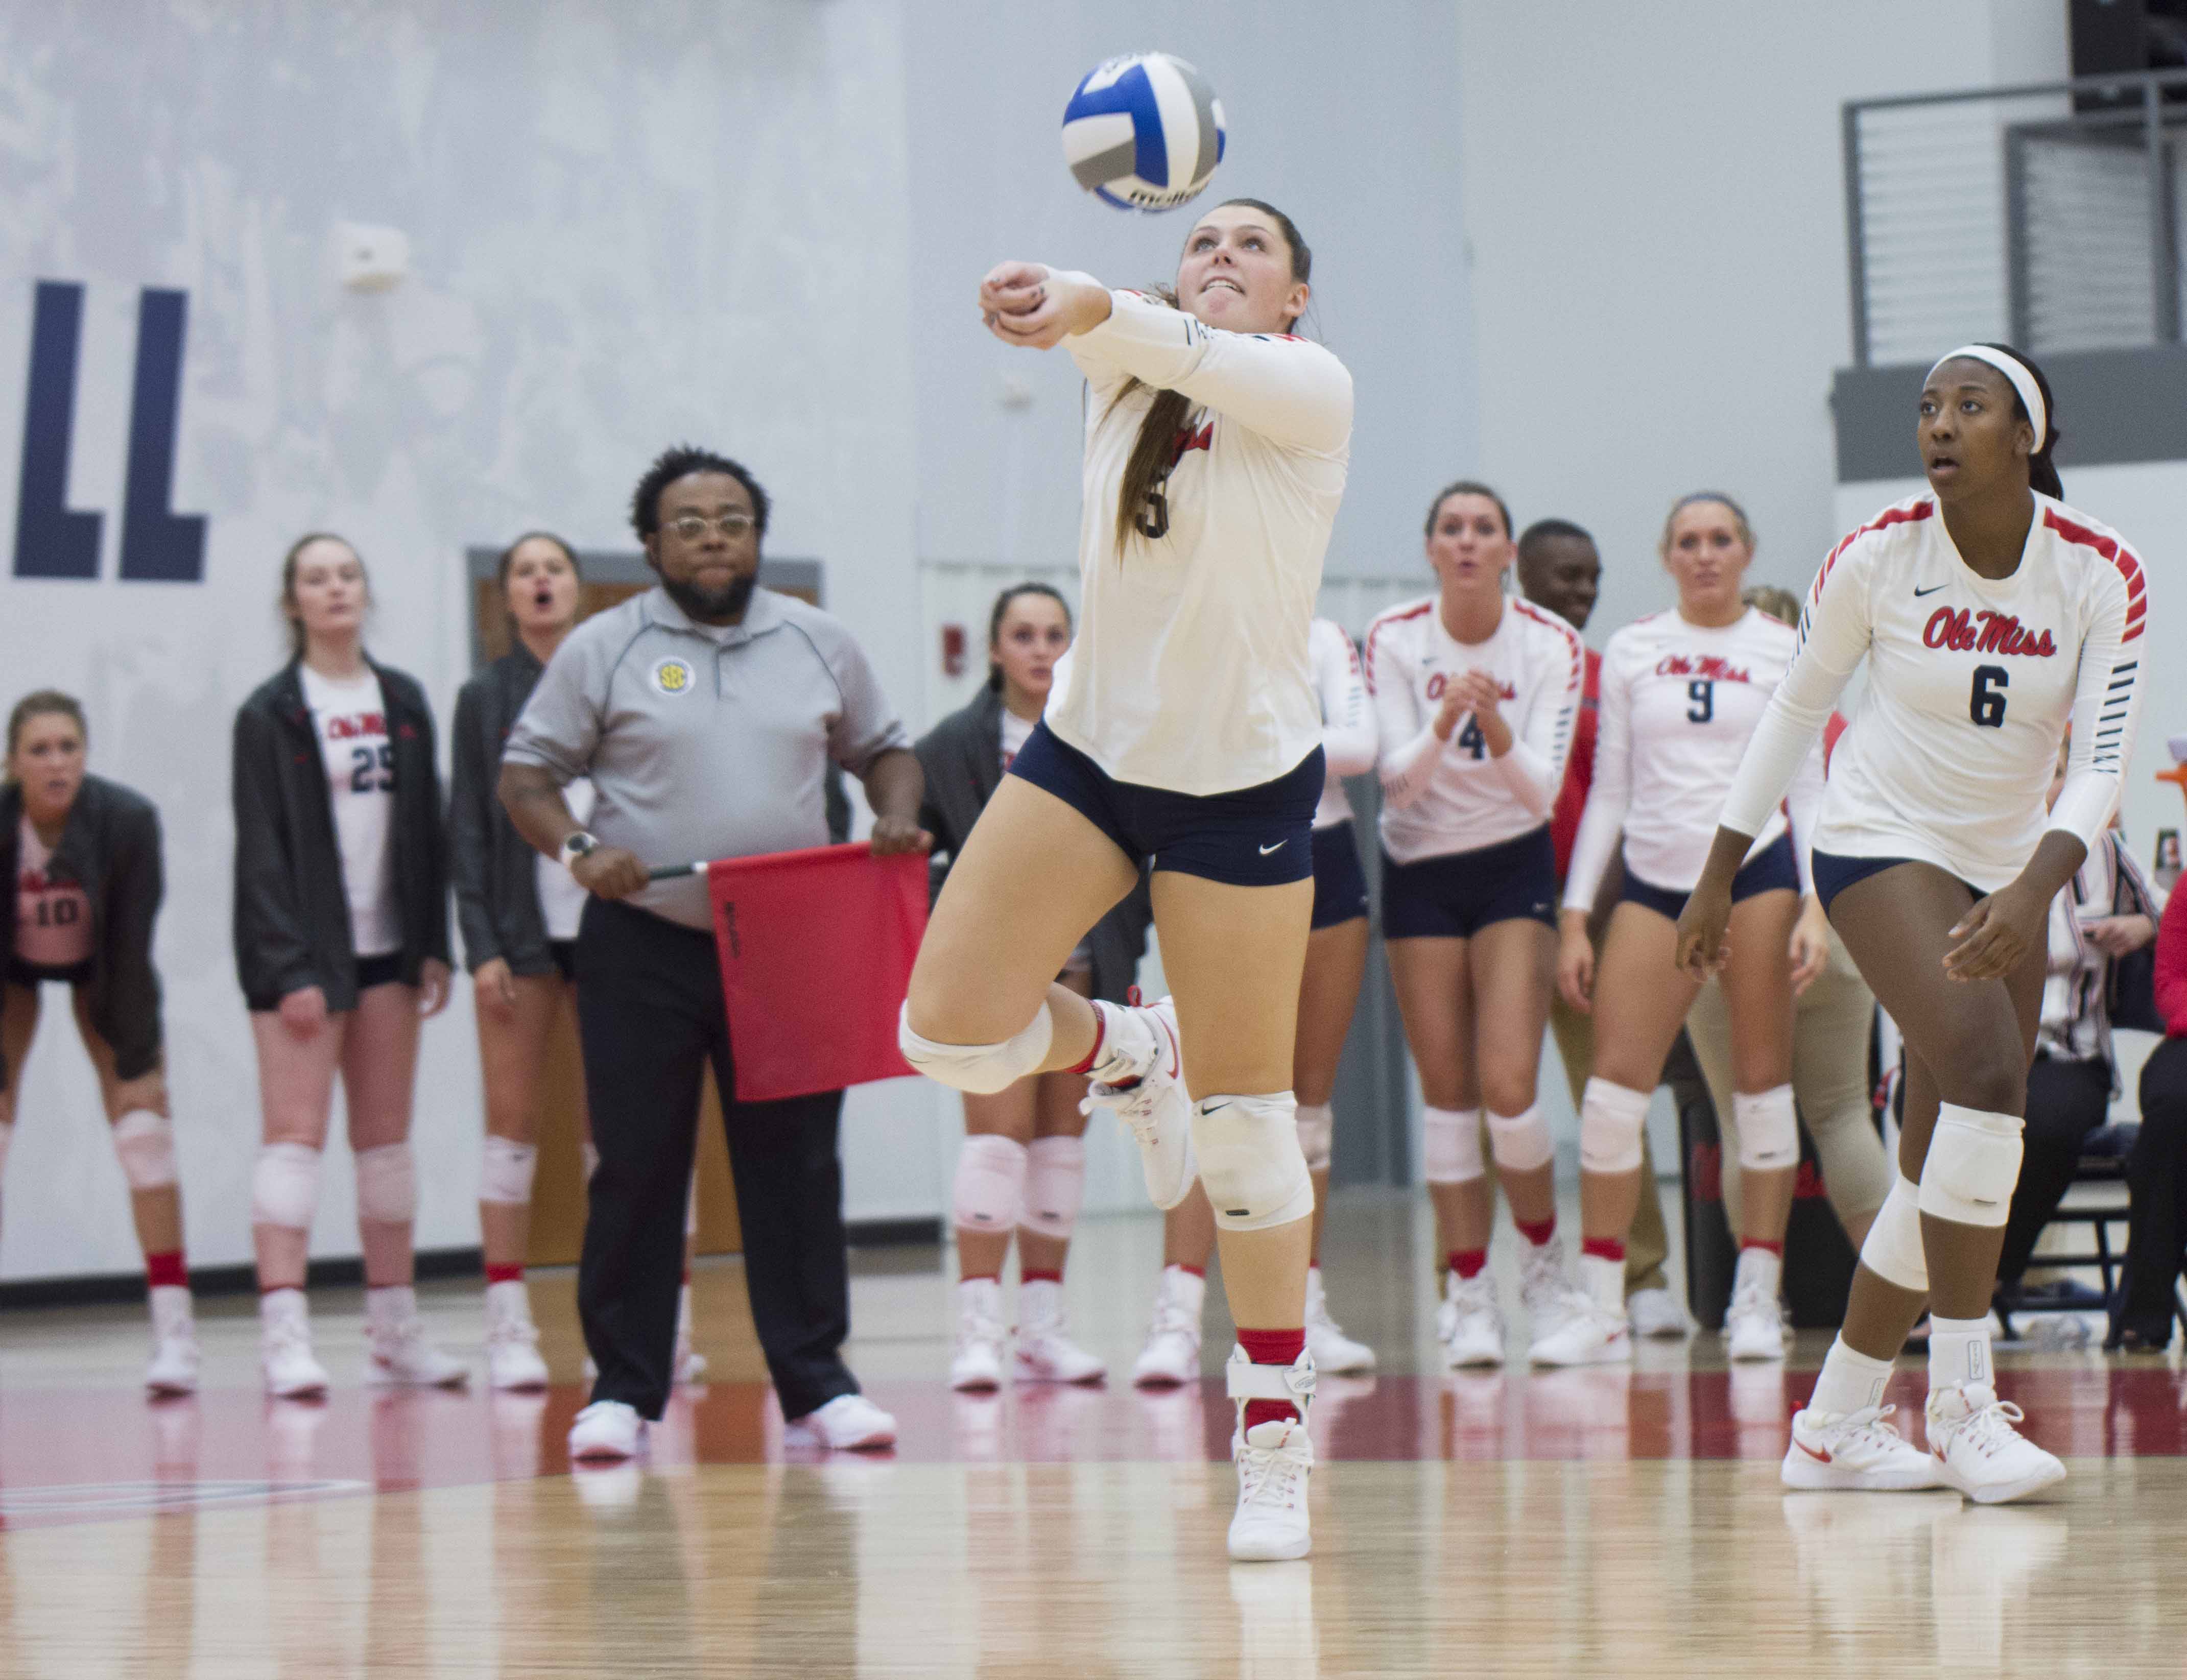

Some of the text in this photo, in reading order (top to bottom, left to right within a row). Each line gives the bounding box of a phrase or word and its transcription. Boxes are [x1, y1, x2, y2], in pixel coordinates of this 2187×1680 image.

[1923, 605, 2057, 657] Ole Miss
[661, 664, 685, 689] SEC
[1970, 664, 2009, 728] 6
[1686, 680, 1714, 723] 9
[1458, 712, 1485, 760] 4
[37, 898, 78, 927] 10
